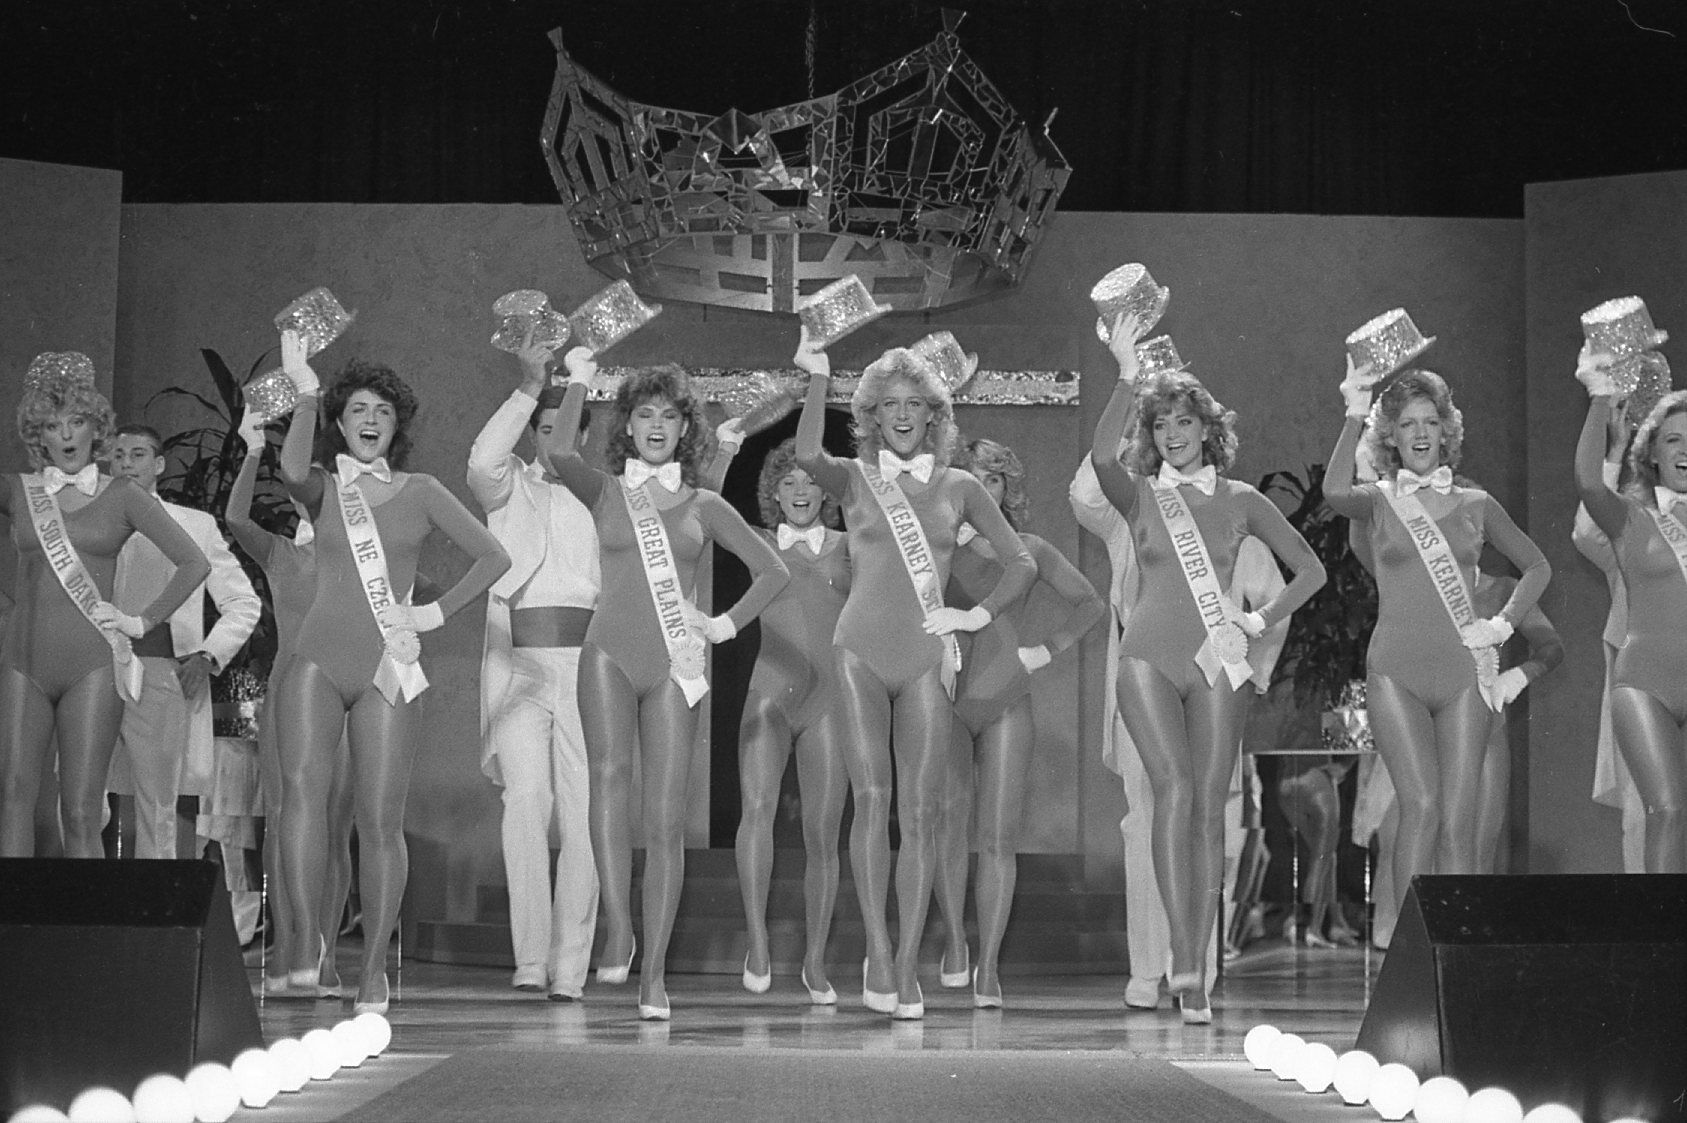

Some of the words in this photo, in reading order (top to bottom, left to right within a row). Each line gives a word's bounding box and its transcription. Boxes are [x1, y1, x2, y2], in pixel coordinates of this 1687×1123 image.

[28, 486, 52, 513] MISS
[40, 520, 73, 571] SOUTH
[341, 492, 367, 526] MISS
[355, 539, 378, 563] NE
[887, 501, 933, 576] KEARNEY
[1407, 515, 1439, 550] MISS
[1429, 554, 1474, 629] KEARNEY
[638, 517, 668, 568] GREAT
[654, 578, 687, 639] PLAINS
[1174, 530, 1208, 581] RIVER
[1198, 591, 1227, 629] CITY
